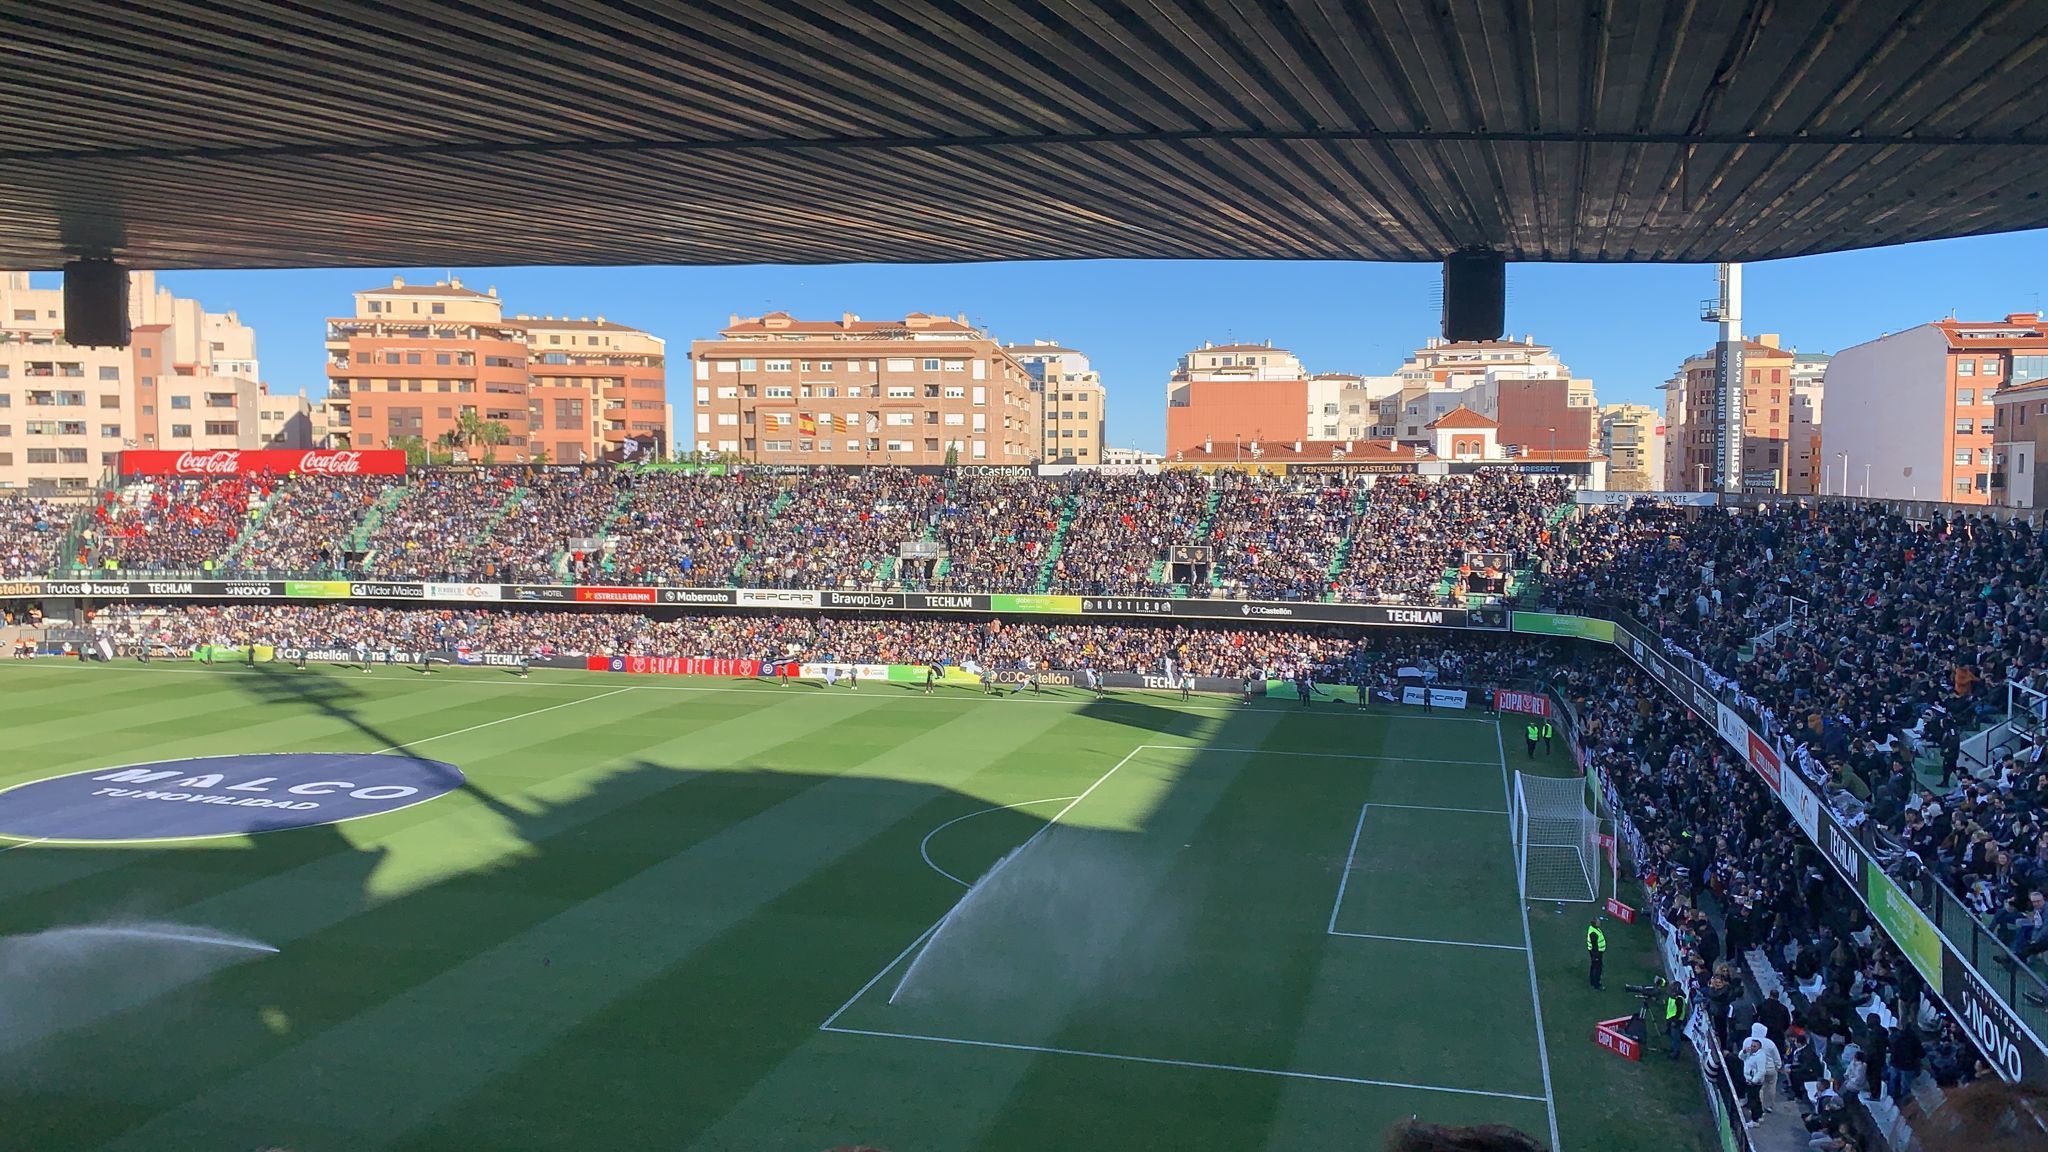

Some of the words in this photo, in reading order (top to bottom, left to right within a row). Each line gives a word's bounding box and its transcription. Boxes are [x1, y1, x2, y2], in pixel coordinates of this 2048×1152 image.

[1718, 387, 1726, 420] DAMM
[1732, 387, 1741, 420] DAMM
[1717, 424, 1726, 472] ESTRELLA
[1731, 424, 1741, 473] ESTRELLA
[176, 450, 241, 473] Coca-Cola
[300, 450, 362, 473] Coca-Cola
[1360, 464, 1402, 474] CASTELLÓN
[47, 583, 80, 595] frutas
[93, 582, 130, 595] bausá
[148, 583, 192, 594] TECHLAM
[234, 586, 271, 596] NOVO
[543, 590, 564, 598] HOTEL
[594, 592, 626, 600] ESTRELLA
[627, 593, 650, 601] DAMM
[677, 591, 728, 602] Maberauto
[743, 592, 814, 602] REPCAR
[831, 592, 894, 608] Bravoplaya
[925, 596, 972, 608] TECHLAM
[1386, 609, 1443, 624] TECHLAM
[650, 657, 680, 674] COPA
[686, 659, 708, 675] DEL
[713, 660, 735, 676] REY
[1500, 692, 1522, 711] COPA
[1532, 695, 1546, 716] REY
[92, 768, 419, 800] MALCO
[92, 787, 134, 798] TU
[132, 790, 320, 810] MOVILIDAD
[1829, 824, 1859, 882] TECHLAM
[1972, 998, 2022, 1084] NOVO
